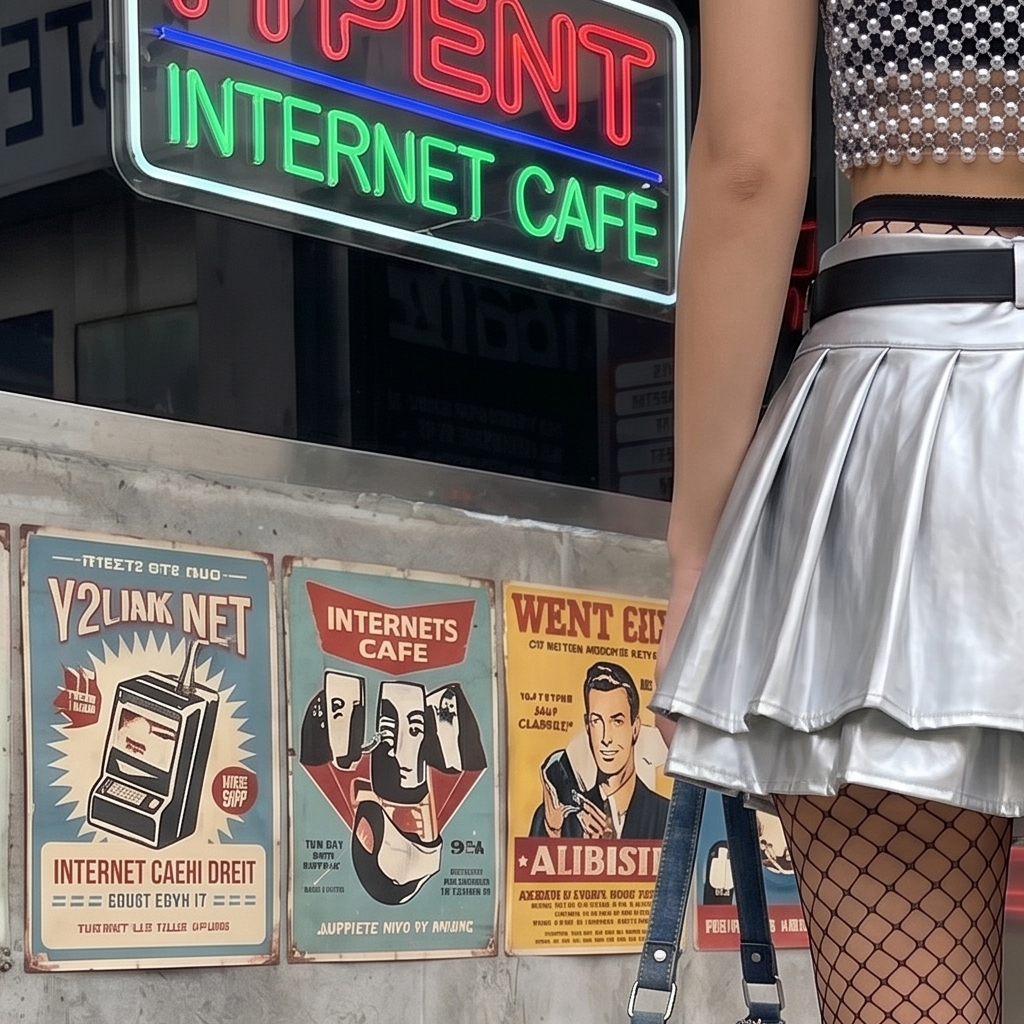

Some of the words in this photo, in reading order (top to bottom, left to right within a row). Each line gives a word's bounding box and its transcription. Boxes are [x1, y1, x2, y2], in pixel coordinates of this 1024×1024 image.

[166, 62, 495, 222] INTERNET
[515, 165, 659, 268] CAFE
[182, 593, 251, 656] NET
[327, 606, 459, 643] INTERNETS
[511, 592, 614, 641] WENT
[359, 638, 429, 663] CAFE
[54, 859, 146, 884] INTERNET
[208, 861, 256, 884] DREIT
